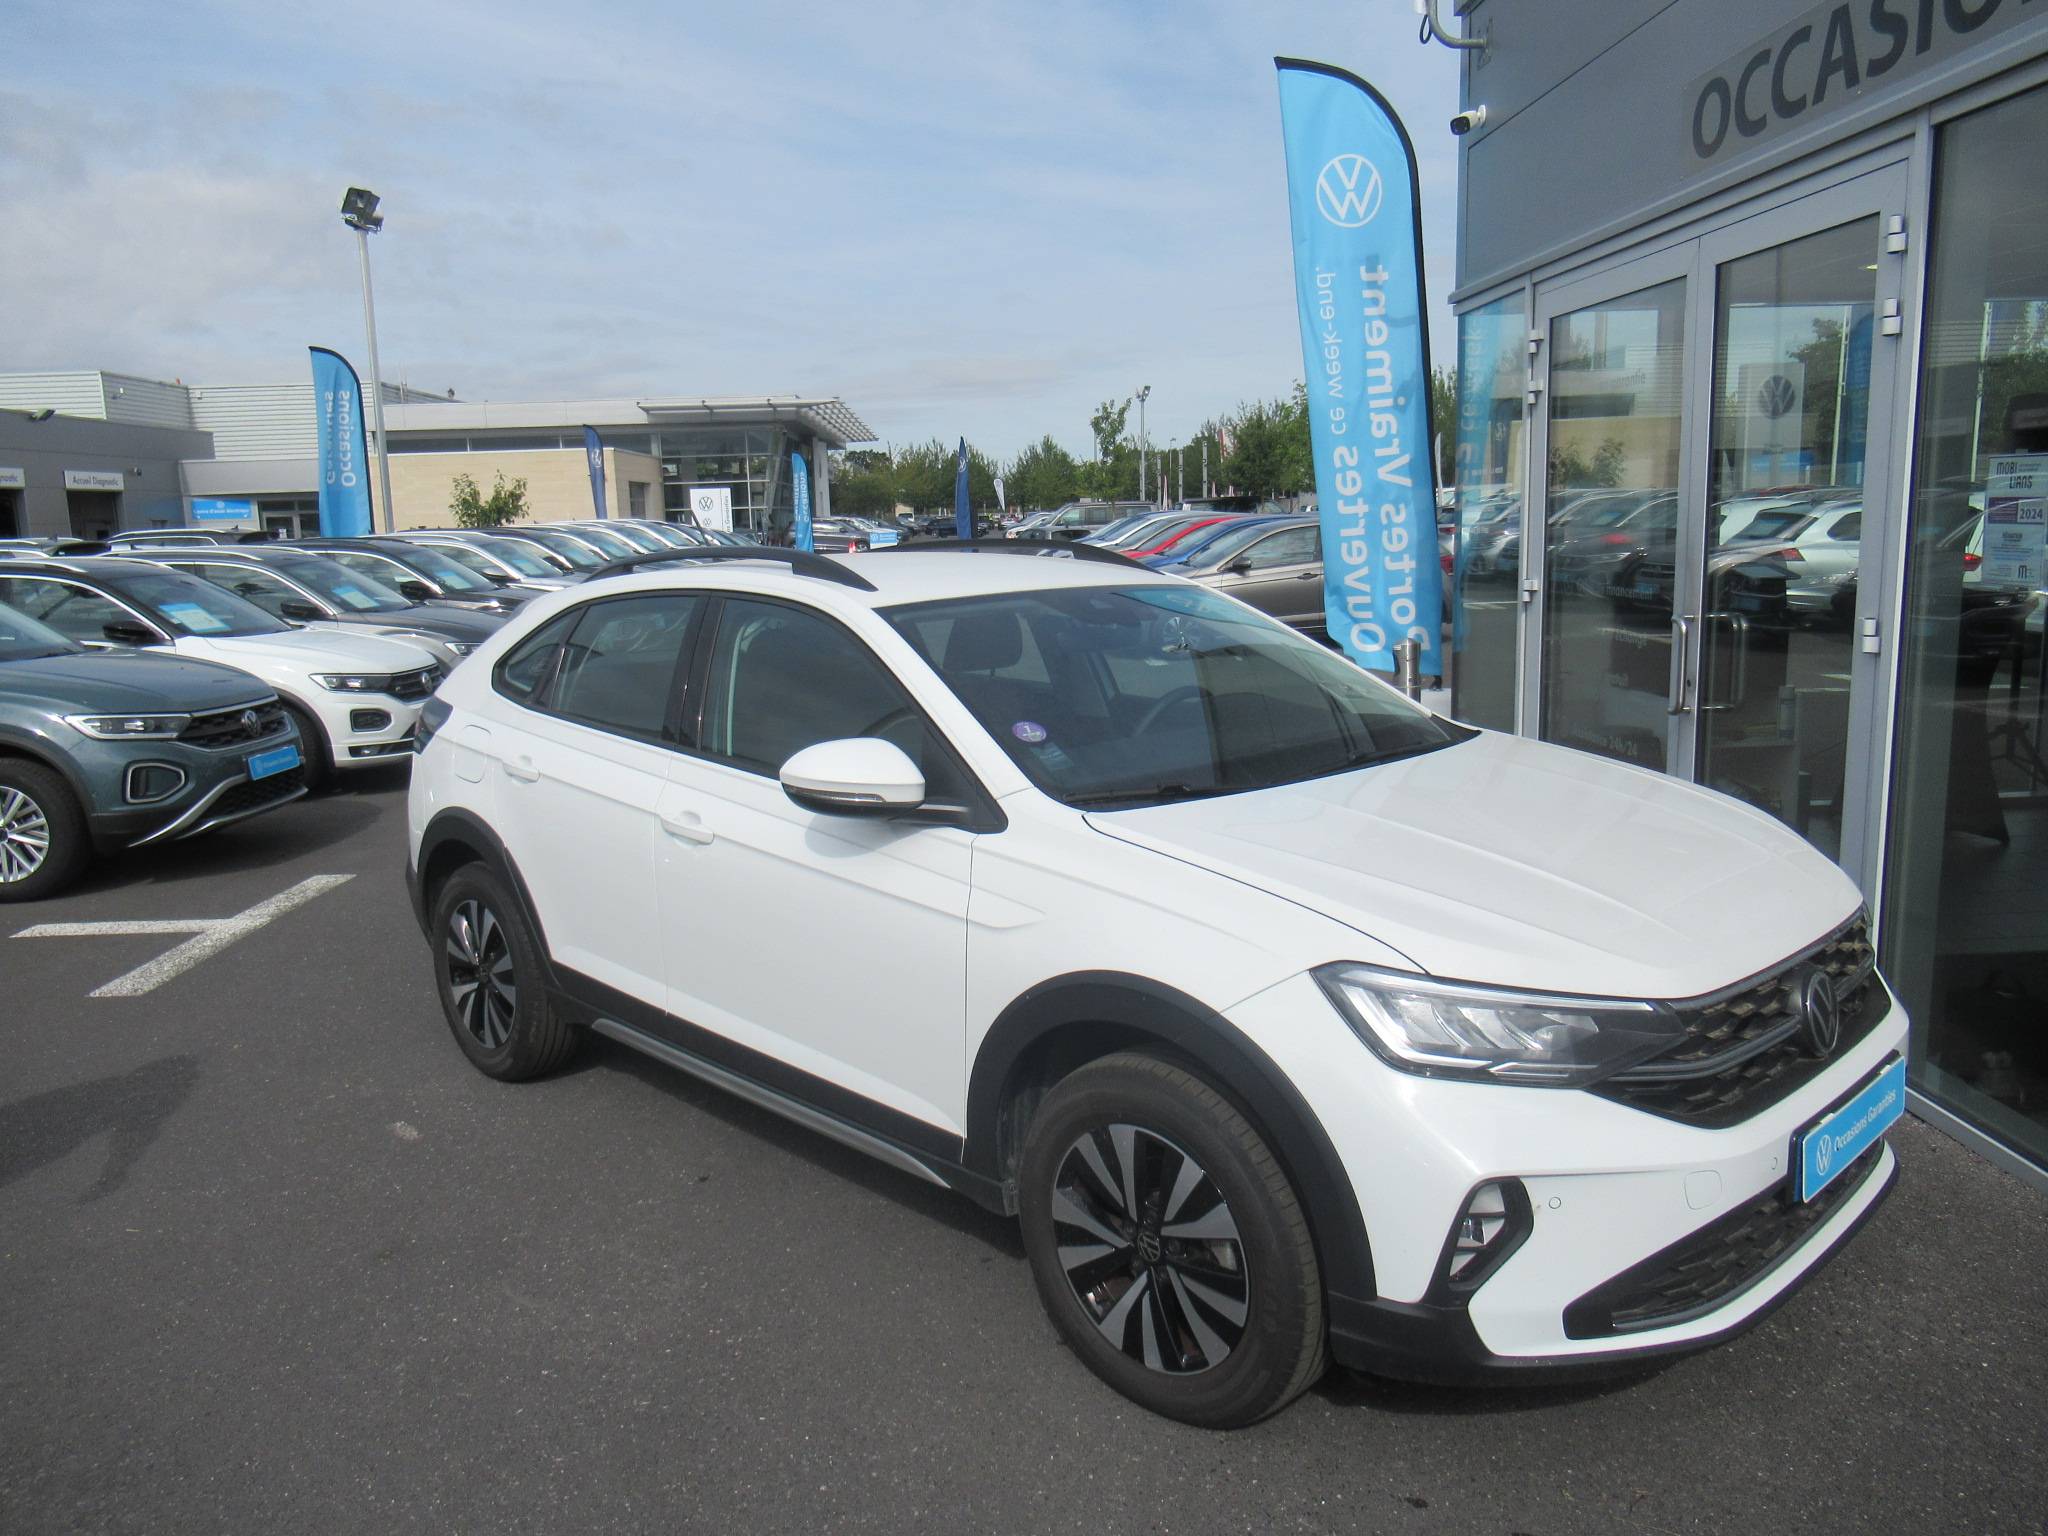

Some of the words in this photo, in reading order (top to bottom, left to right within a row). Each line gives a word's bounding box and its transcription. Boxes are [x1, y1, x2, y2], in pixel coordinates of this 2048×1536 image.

[1692, 0, 2048, 159] OCCASI
[2019, 507, 2043, 520] 2024
[1834, 1117, 1868, 1152] Occasions
[1867, 1089, 1897, 1122] Garanties
